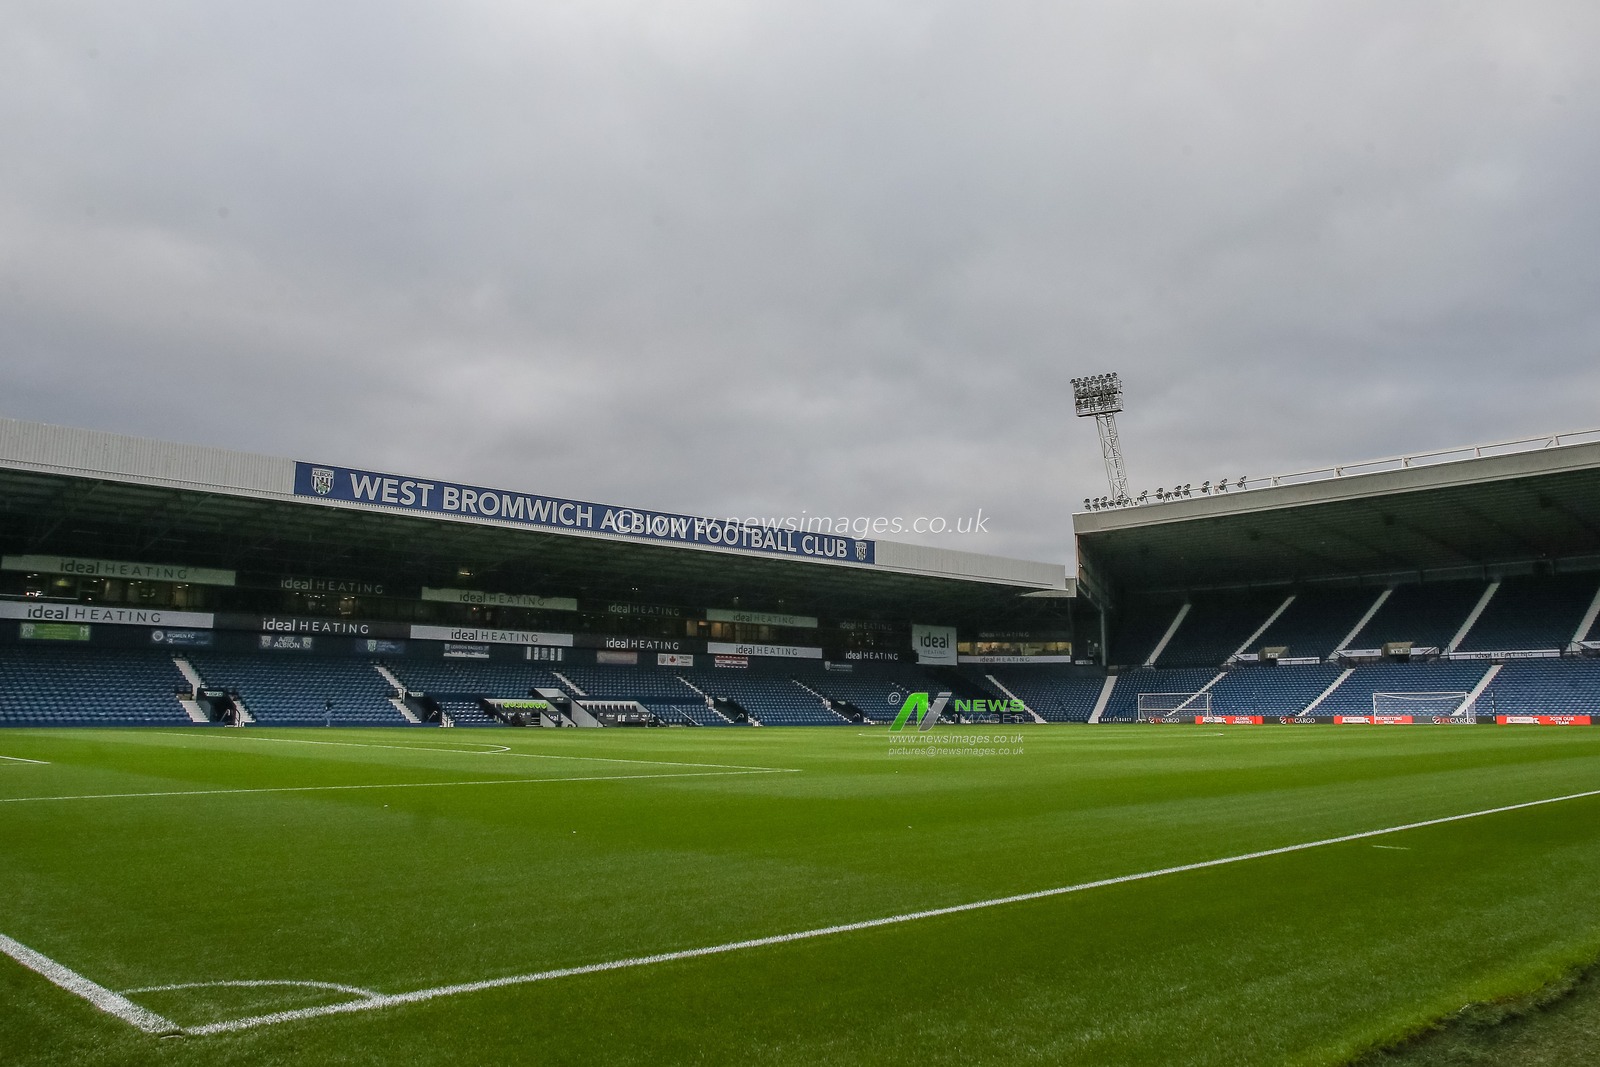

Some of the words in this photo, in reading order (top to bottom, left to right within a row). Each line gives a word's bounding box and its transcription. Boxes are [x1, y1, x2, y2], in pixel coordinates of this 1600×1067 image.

[350, 473, 434, 507] WEST
[442, 486, 593, 528] BROMWICH
[600, 508, 687, 539] ALBION
[694, 520, 797, 552] FOOTBALL
[801, 535, 848, 558] CLUB
[60, 559, 100, 575] ideal
[104, 563, 188, 580] HEATING
[281, 577, 313, 590] ideal
[317, 580, 384, 595] HEATING
[459, 592, 486, 604] ideal
[489, 594, 545, 607] HEATING
[27, 605, 69, 620] ideal
[74, 608, 162, 623] HEATING
[608, 603, 631, 614] ideal
[633, 605, 680, 617] HEATING
[263, 618, 296, 632] ideal
[299, 620, 369, 634] HEATING
[733, 613, 752, 623] ideal
[754, 614, 795, 625] HEATING
[840, 620, 856, 630] ideal
[858, 622, 892, 631] HEATING
[451, 629, 478, 641] ideal
[481, 631, 539, 643] HEATING
[920, 632, 949, 649] ideal
[273, 641, 301, 649] ALBION
[606, 637, 629, 649] ideal
[631, 639, 679, 650] HEATING
[735, 644, 755, 655] ideal
[757, 645, 798, 656] HEATING
[845, 650, 862, 660] ideal
[863, 651, 898, 661] HEATING
